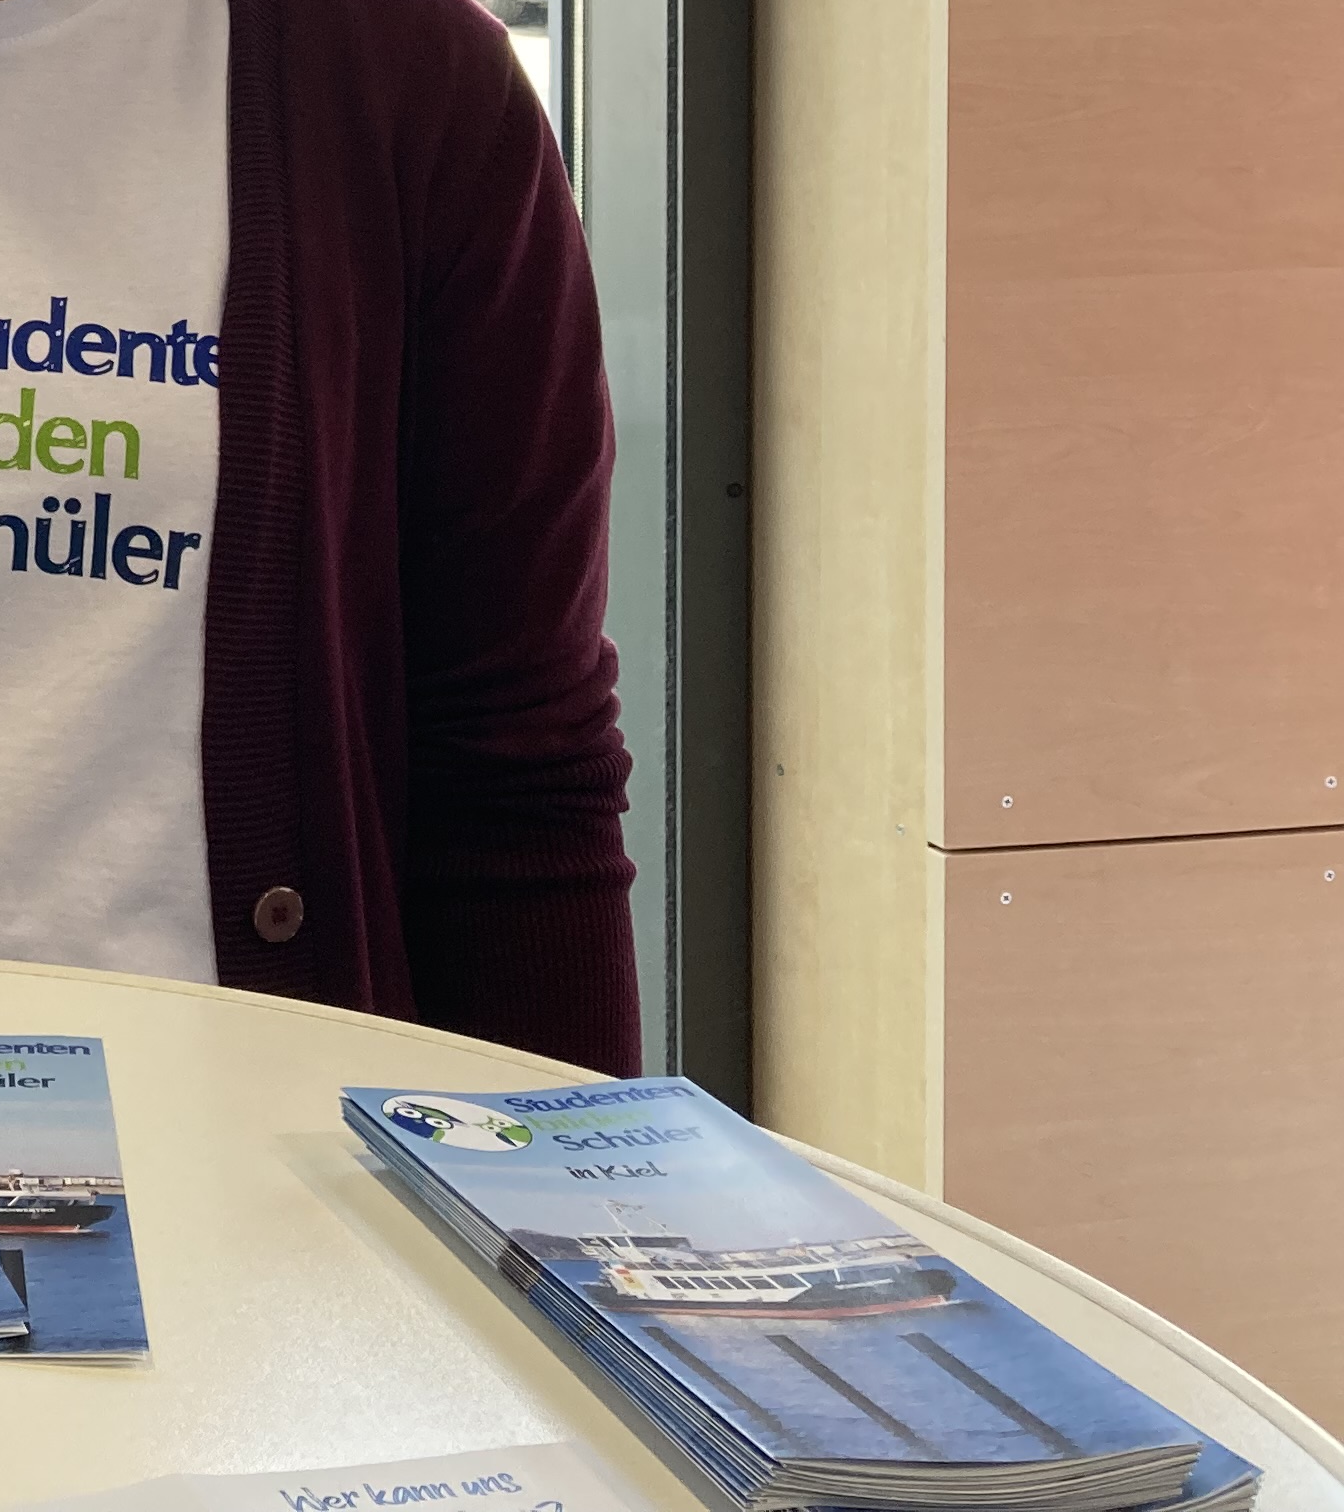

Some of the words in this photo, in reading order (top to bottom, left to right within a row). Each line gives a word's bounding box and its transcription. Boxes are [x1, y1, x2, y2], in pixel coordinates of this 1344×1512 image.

[504, 1084, 698, 1114] Studenten
[552, 1125, 705, 1152] Schüler
[564, 1165, 599, 1180] in
[594, 1160, 668, 1181] Kiel
[362, 1481, 458, 1506] kann
[461, 1472, 523, 1497] uns
